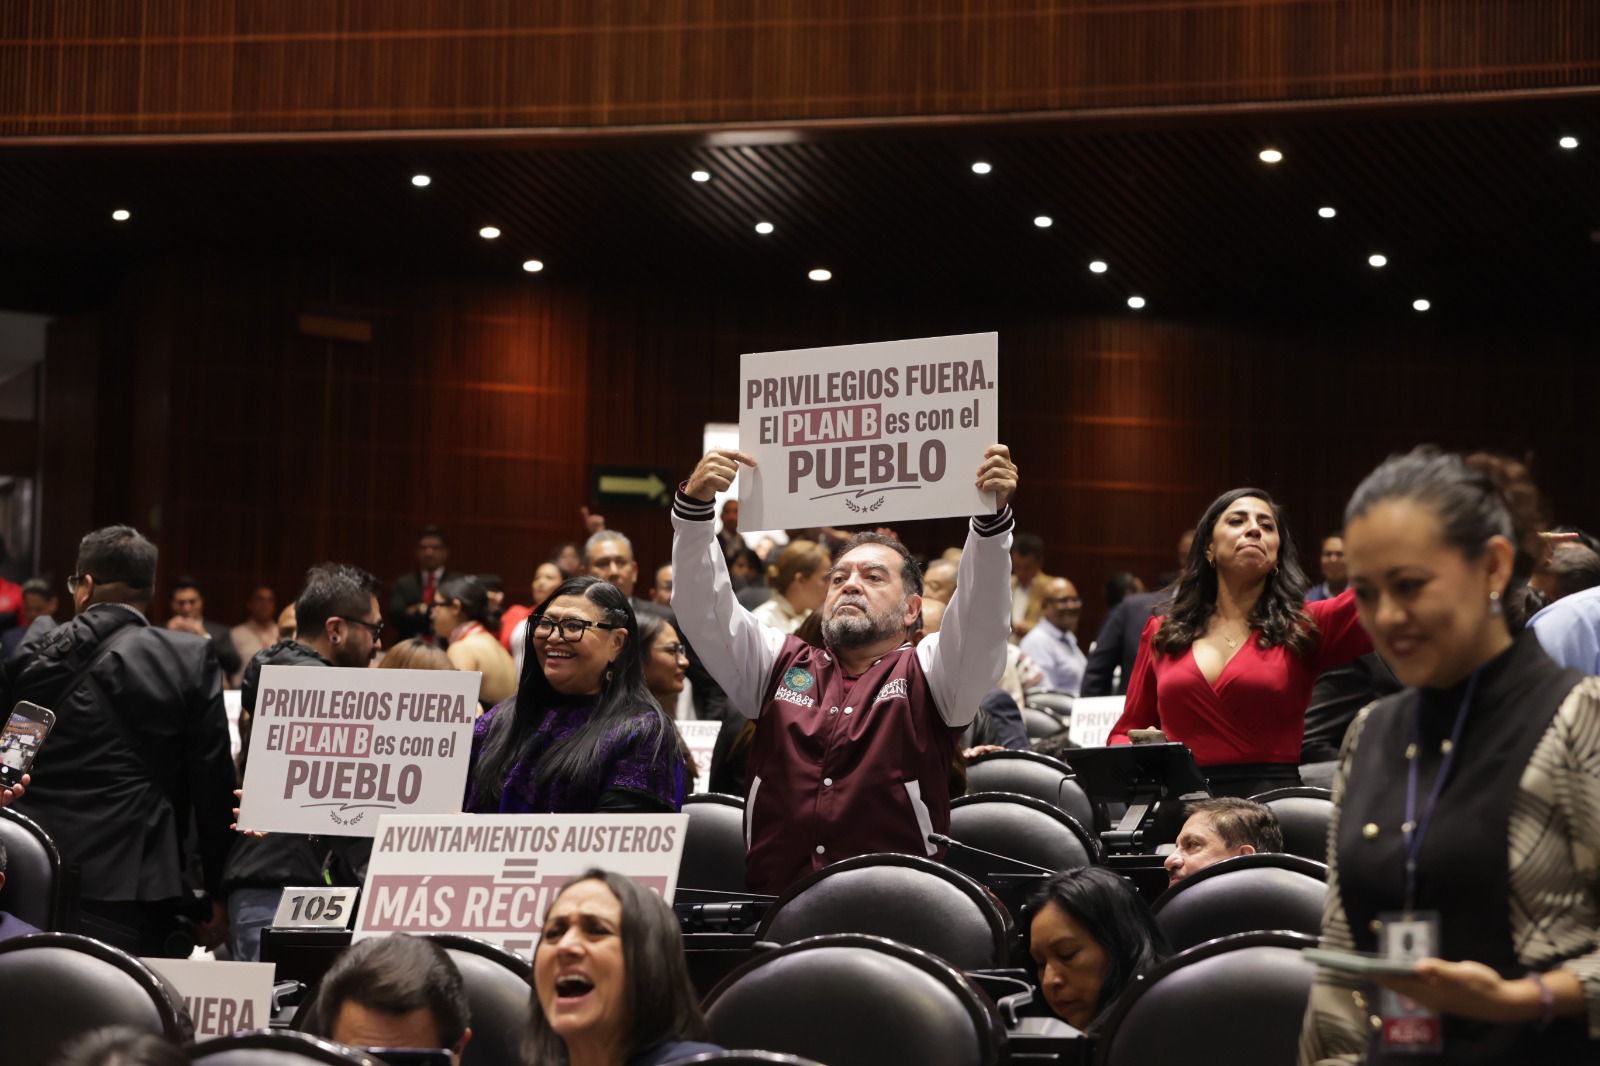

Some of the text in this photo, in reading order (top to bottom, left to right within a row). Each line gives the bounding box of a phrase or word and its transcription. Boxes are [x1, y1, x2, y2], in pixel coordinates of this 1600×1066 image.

[746, 359, 995, 410] PRIVILEGIOS FUERA.
[759, 399, 979, 444] El PLAN B es con el
[788, 439, 947, 494] PUEBLO
[260, 688, 472, 724] PRIVILEGIOS FUERA.
[266, 724, 457, 758] El PLAN B es con el
[283, 759, 423, 805] PUEBLO
[379, 825, 677, 853] AYUNTAMIENTOS AUSTEROS
[291, 895, 347, 921] 105
[371, 876, 456, 927] MÁS
[184, 996, 255, 1036] UERA
